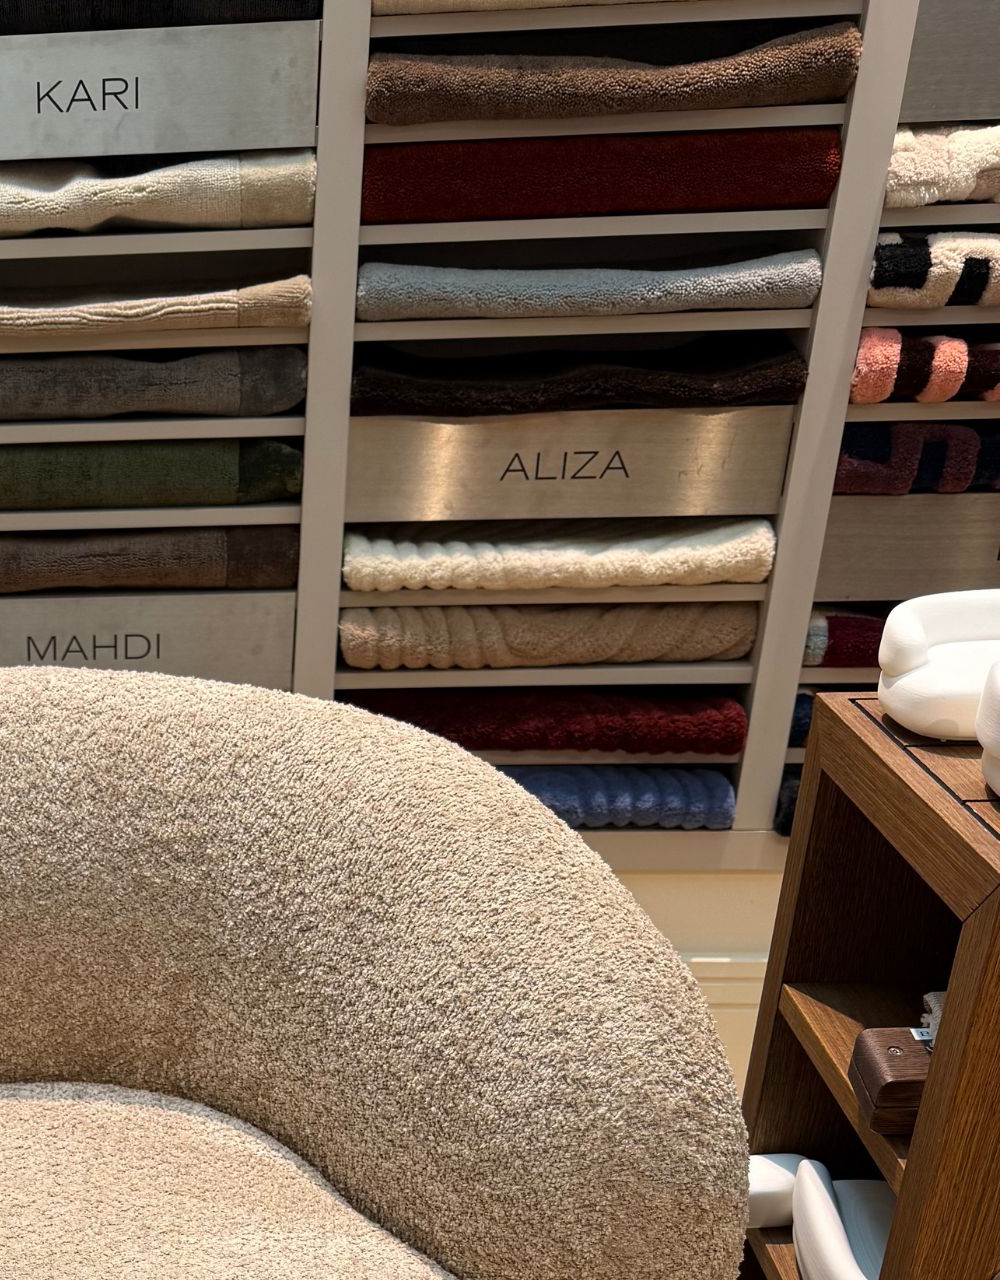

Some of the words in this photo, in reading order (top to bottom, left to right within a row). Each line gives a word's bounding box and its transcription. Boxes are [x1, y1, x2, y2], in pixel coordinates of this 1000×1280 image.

[35, 76, 140, 115] KARI
[499, 450, 631, 482] ALIZA
[26, 633, 162, 662] MAHDI
